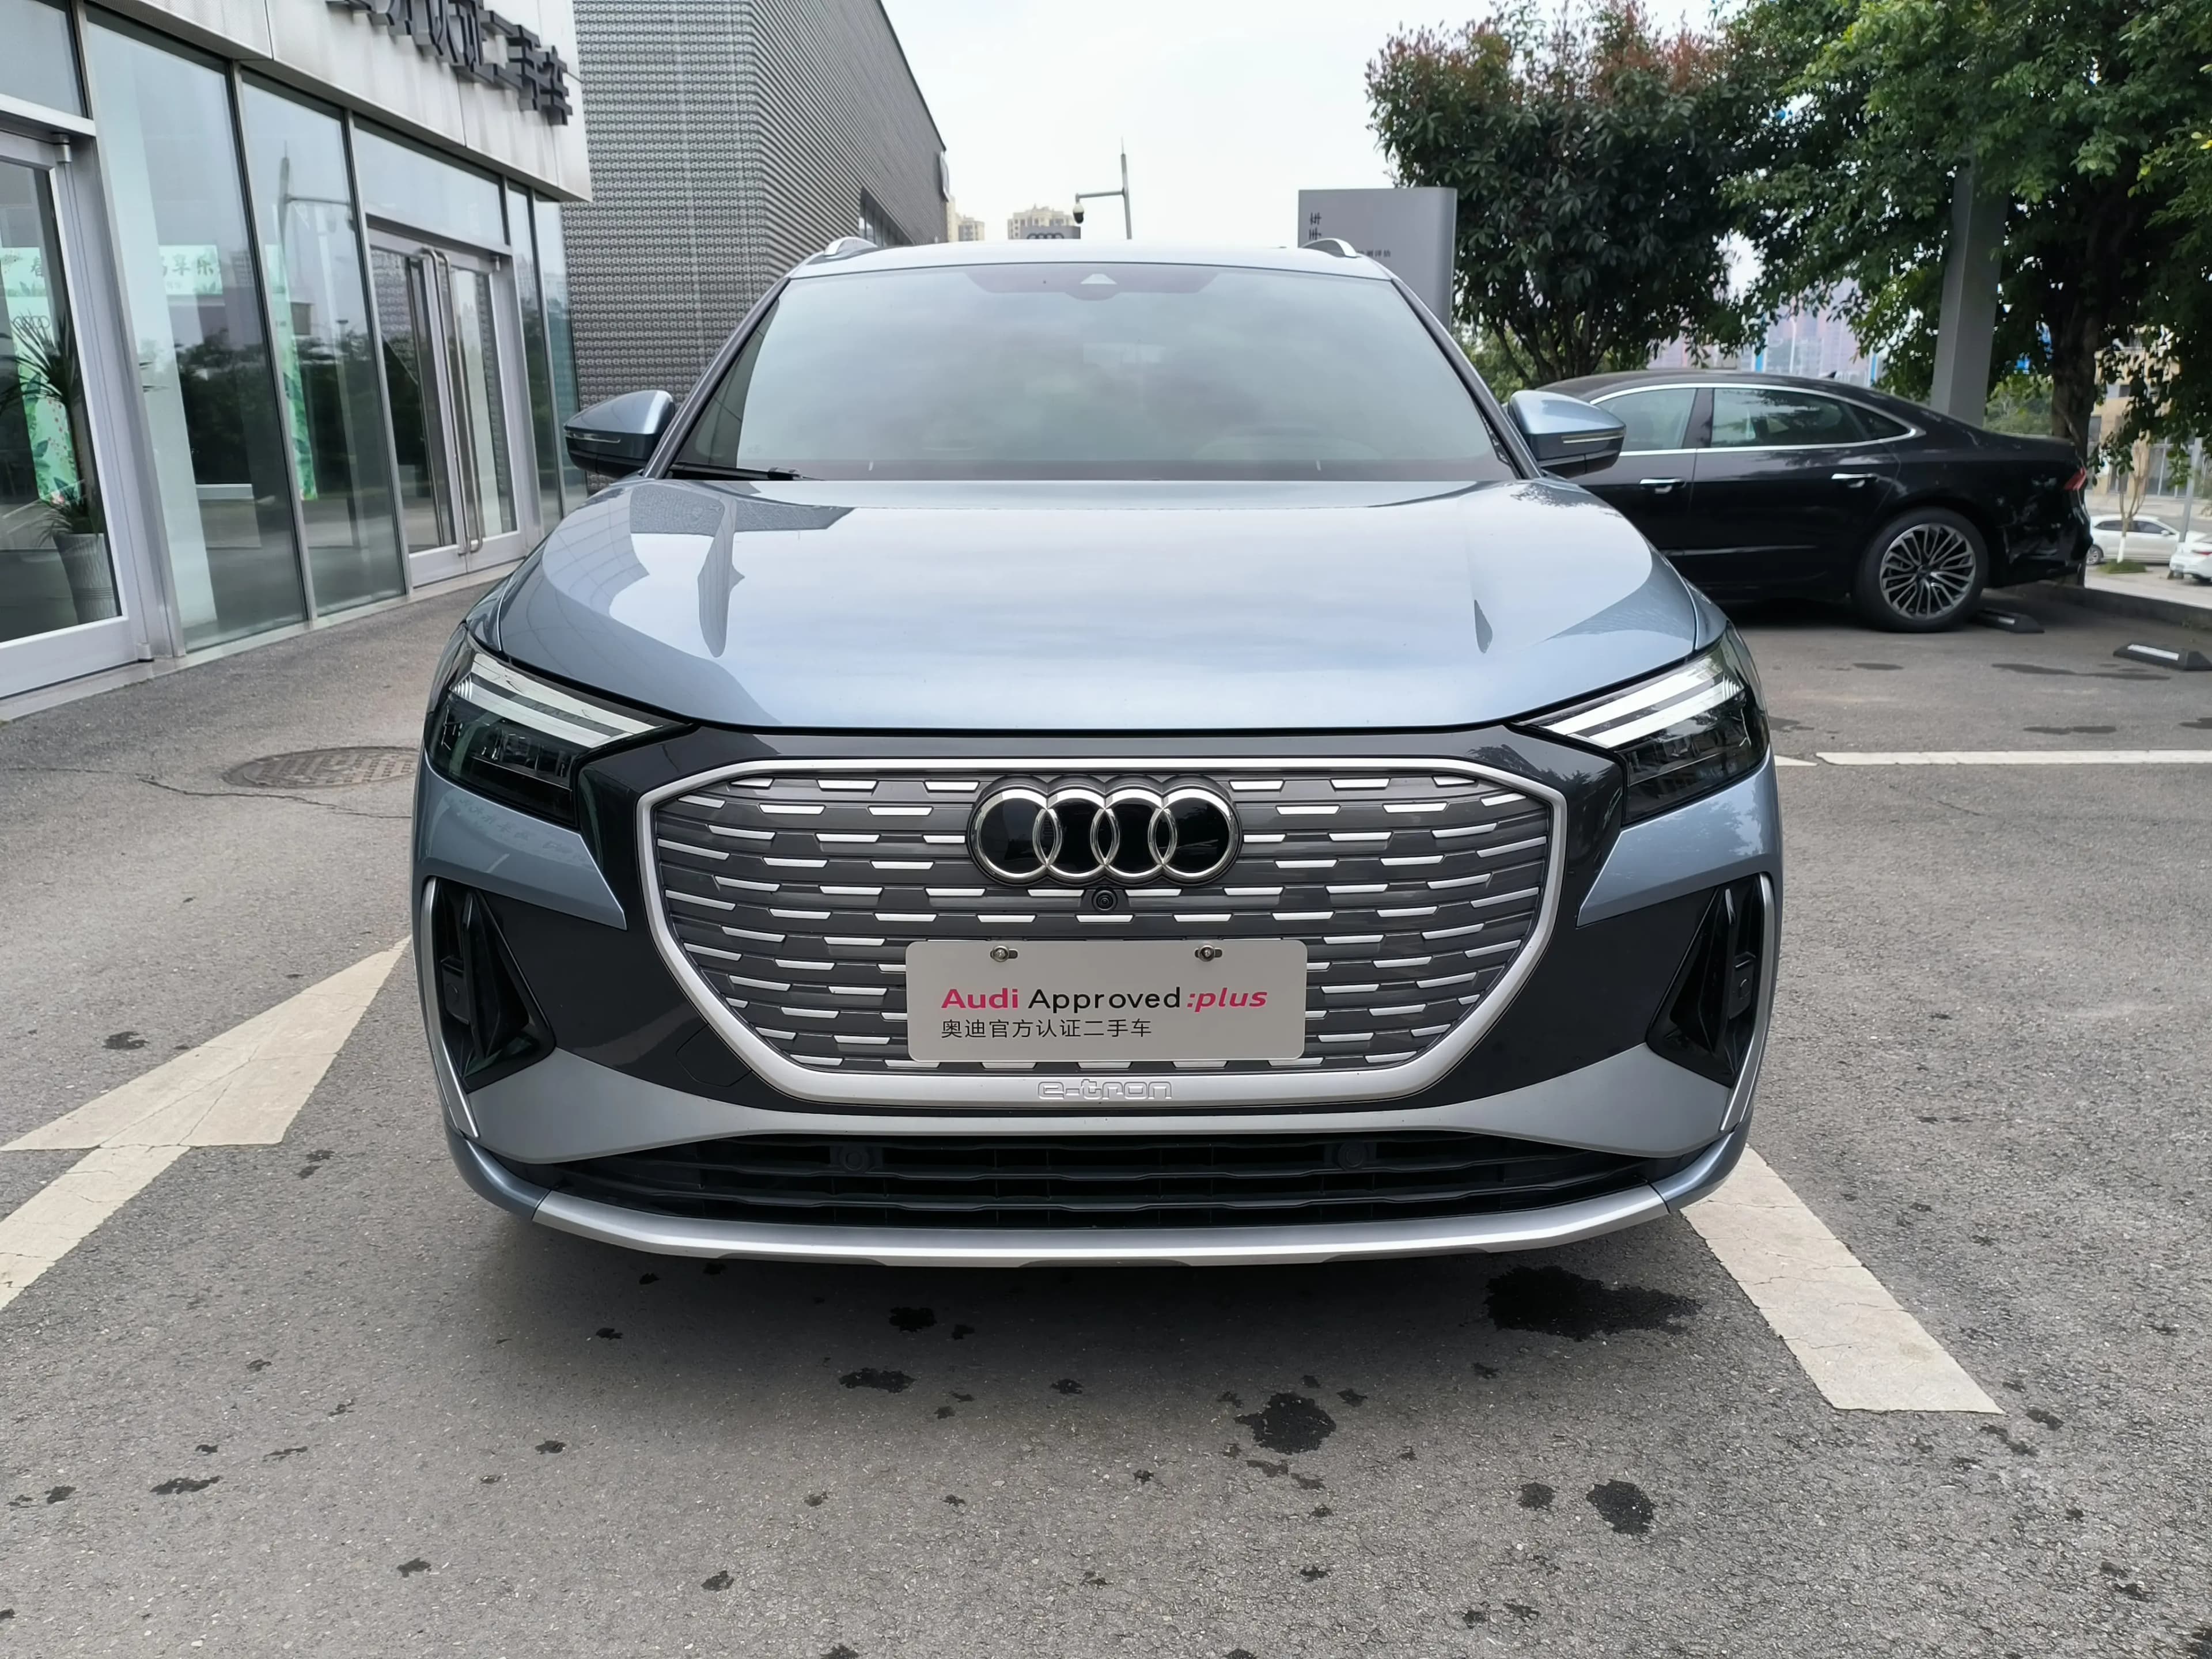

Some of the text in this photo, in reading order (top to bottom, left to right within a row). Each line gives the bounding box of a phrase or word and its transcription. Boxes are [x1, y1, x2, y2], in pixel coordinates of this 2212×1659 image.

[941, 987, 1268, 1013] Audi Approved :plus
[941, 1018, 1152, 1038] 奥迪官方认证二手车
[1038, 1079, 1172, 1100] e-tron
